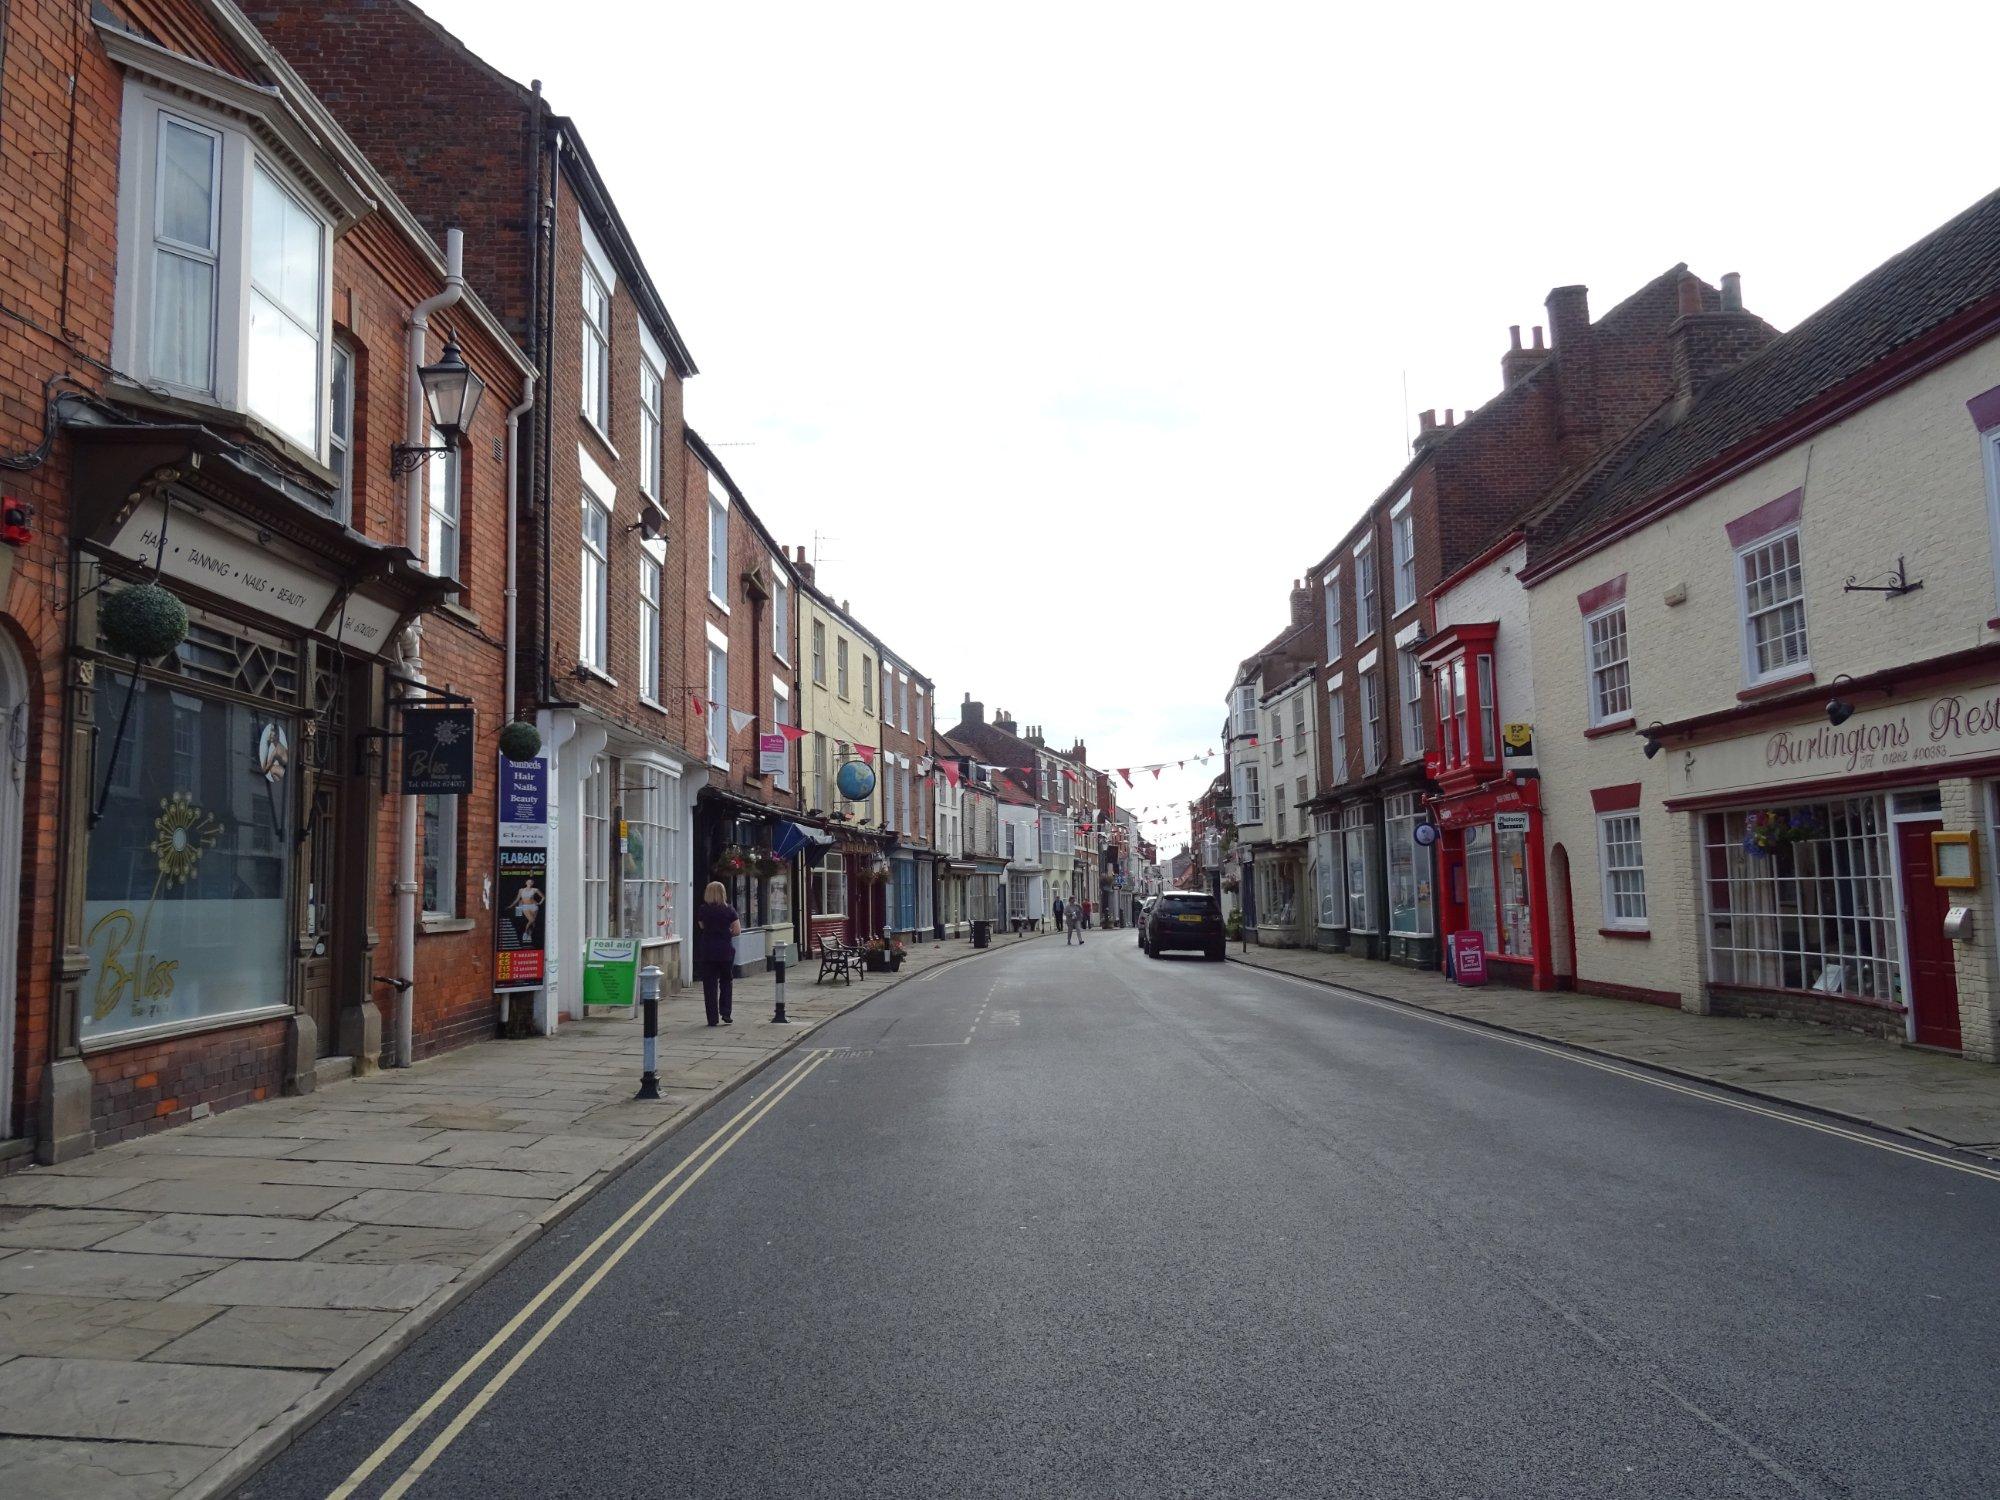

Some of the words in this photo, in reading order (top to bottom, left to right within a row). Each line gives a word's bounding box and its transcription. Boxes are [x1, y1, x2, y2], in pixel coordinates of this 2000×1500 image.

[187, 549, 230, 577] TANNING
[241, 573, 268, 592] NAILS
[277, 587, 307, 608] BEAUTY
[1766, 717, 1910, 772] Burlingtons
[408, 749, 448, 776] Bliss
[514, 772, 535, 780] Hair
[513, 783, 537, 791] Nails
[510, 794, 538, 804] Beauty
[500, 852, 546, 865] FLABéLOS
[616, 941, 632, 949] aid
[87, 908, 180, 1021] Bliss
